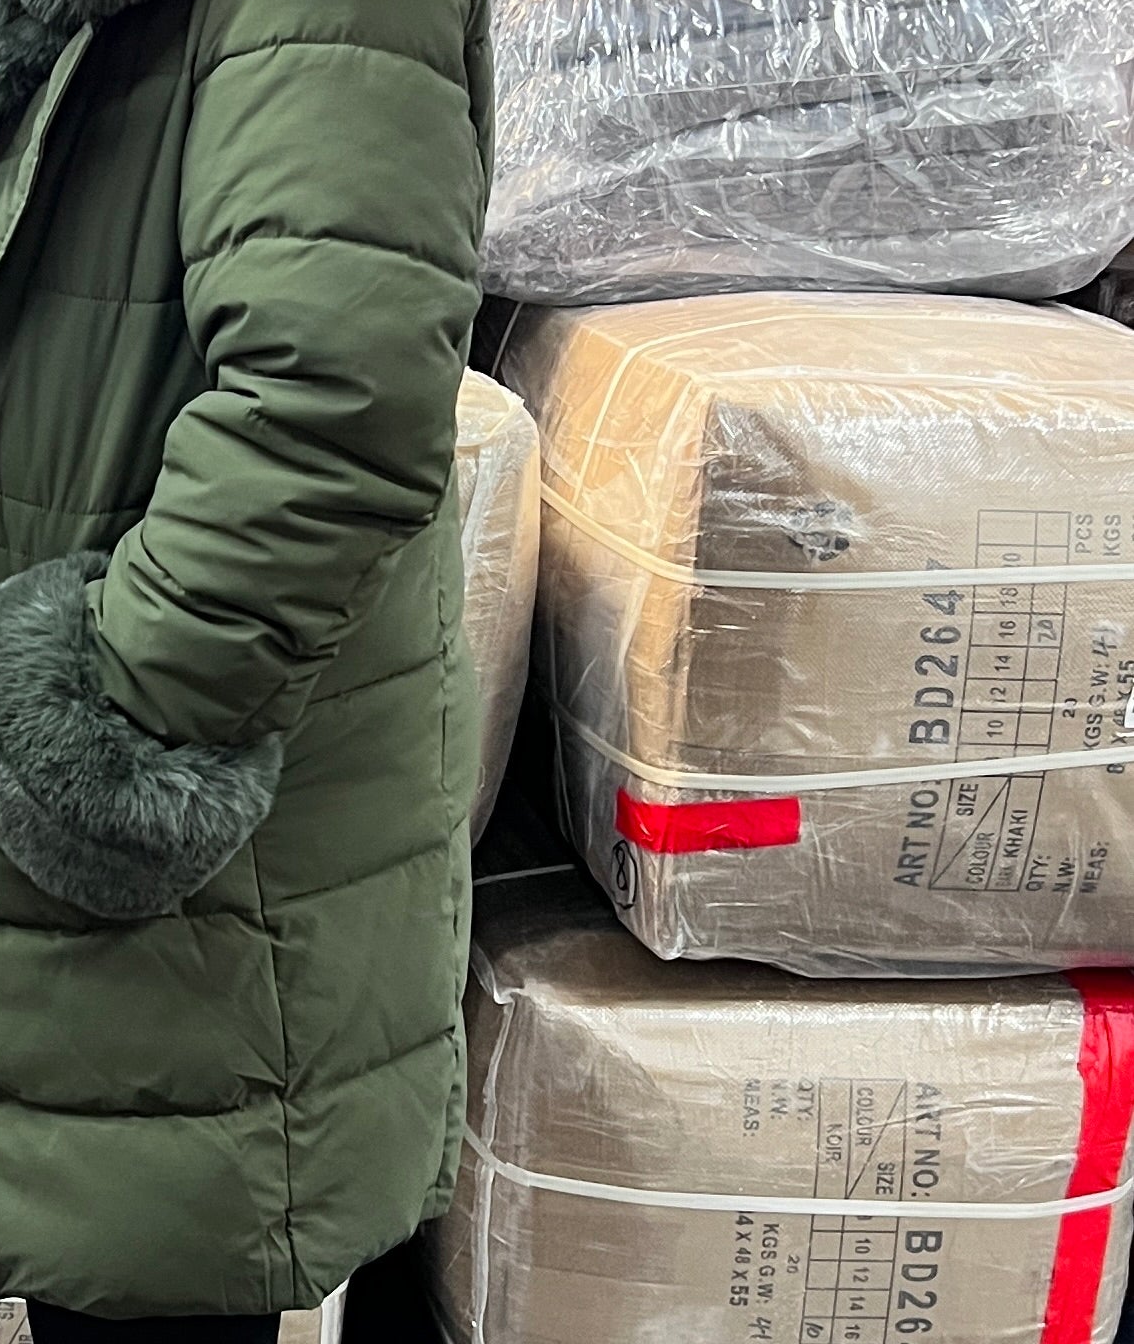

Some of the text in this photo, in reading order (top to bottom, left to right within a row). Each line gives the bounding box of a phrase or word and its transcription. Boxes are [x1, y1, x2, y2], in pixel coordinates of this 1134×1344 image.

[1000, 587, 1019, 607] 18
[1088, 663, 1111, 706] G.W:
[1102, 514, 1122, 557] KGS
[999, 620, 1016, 639] 16
[994, 655, 1011, 672] 14
[990, 687, 1007, 704] 12
[1026, 855, 1051, 892] QTY:
[1074, 513, 1094, 554] PCS
[987, 719, 1004, 738] 10
[1003, 809, 1028, 858] KHAKI
[1038, 619, 1057, 643] 20
[956, 783, 979, 817] SIZE
[893, 837, 931, 887] ART
[966, 832, 995, 885] COLOUR
[1079, 841, 1111, 894] MEAS:
[742, 1078, 760, 1138] MEAS:
[855, 1087, 874, 1147] COLOUR
[916, 1082, 942, 1141] ART
[786, 1079, 814, 1275] QTY: 20
[875, 1162, 895, 1196] SIZE
[911, 1149, 940, 1198] NO:
[735, 1230, 752, 1243] X
[760, 1223, 780, 1260] KGS
[855, 1238, 871, 1254] 10
[734, 1247, 752, 1265] 48
[731, 1270, 749, 1281] X
[756, 1265, 776, 1304] G.W:
[852, 1267, 870, 1283] 12
[729, 1285, 749, 1307] 55
[849, 1296, 865, 1312] 14
[805, 1321, 824, 1339] 10
[844, 1324, 861, 1341] 16
